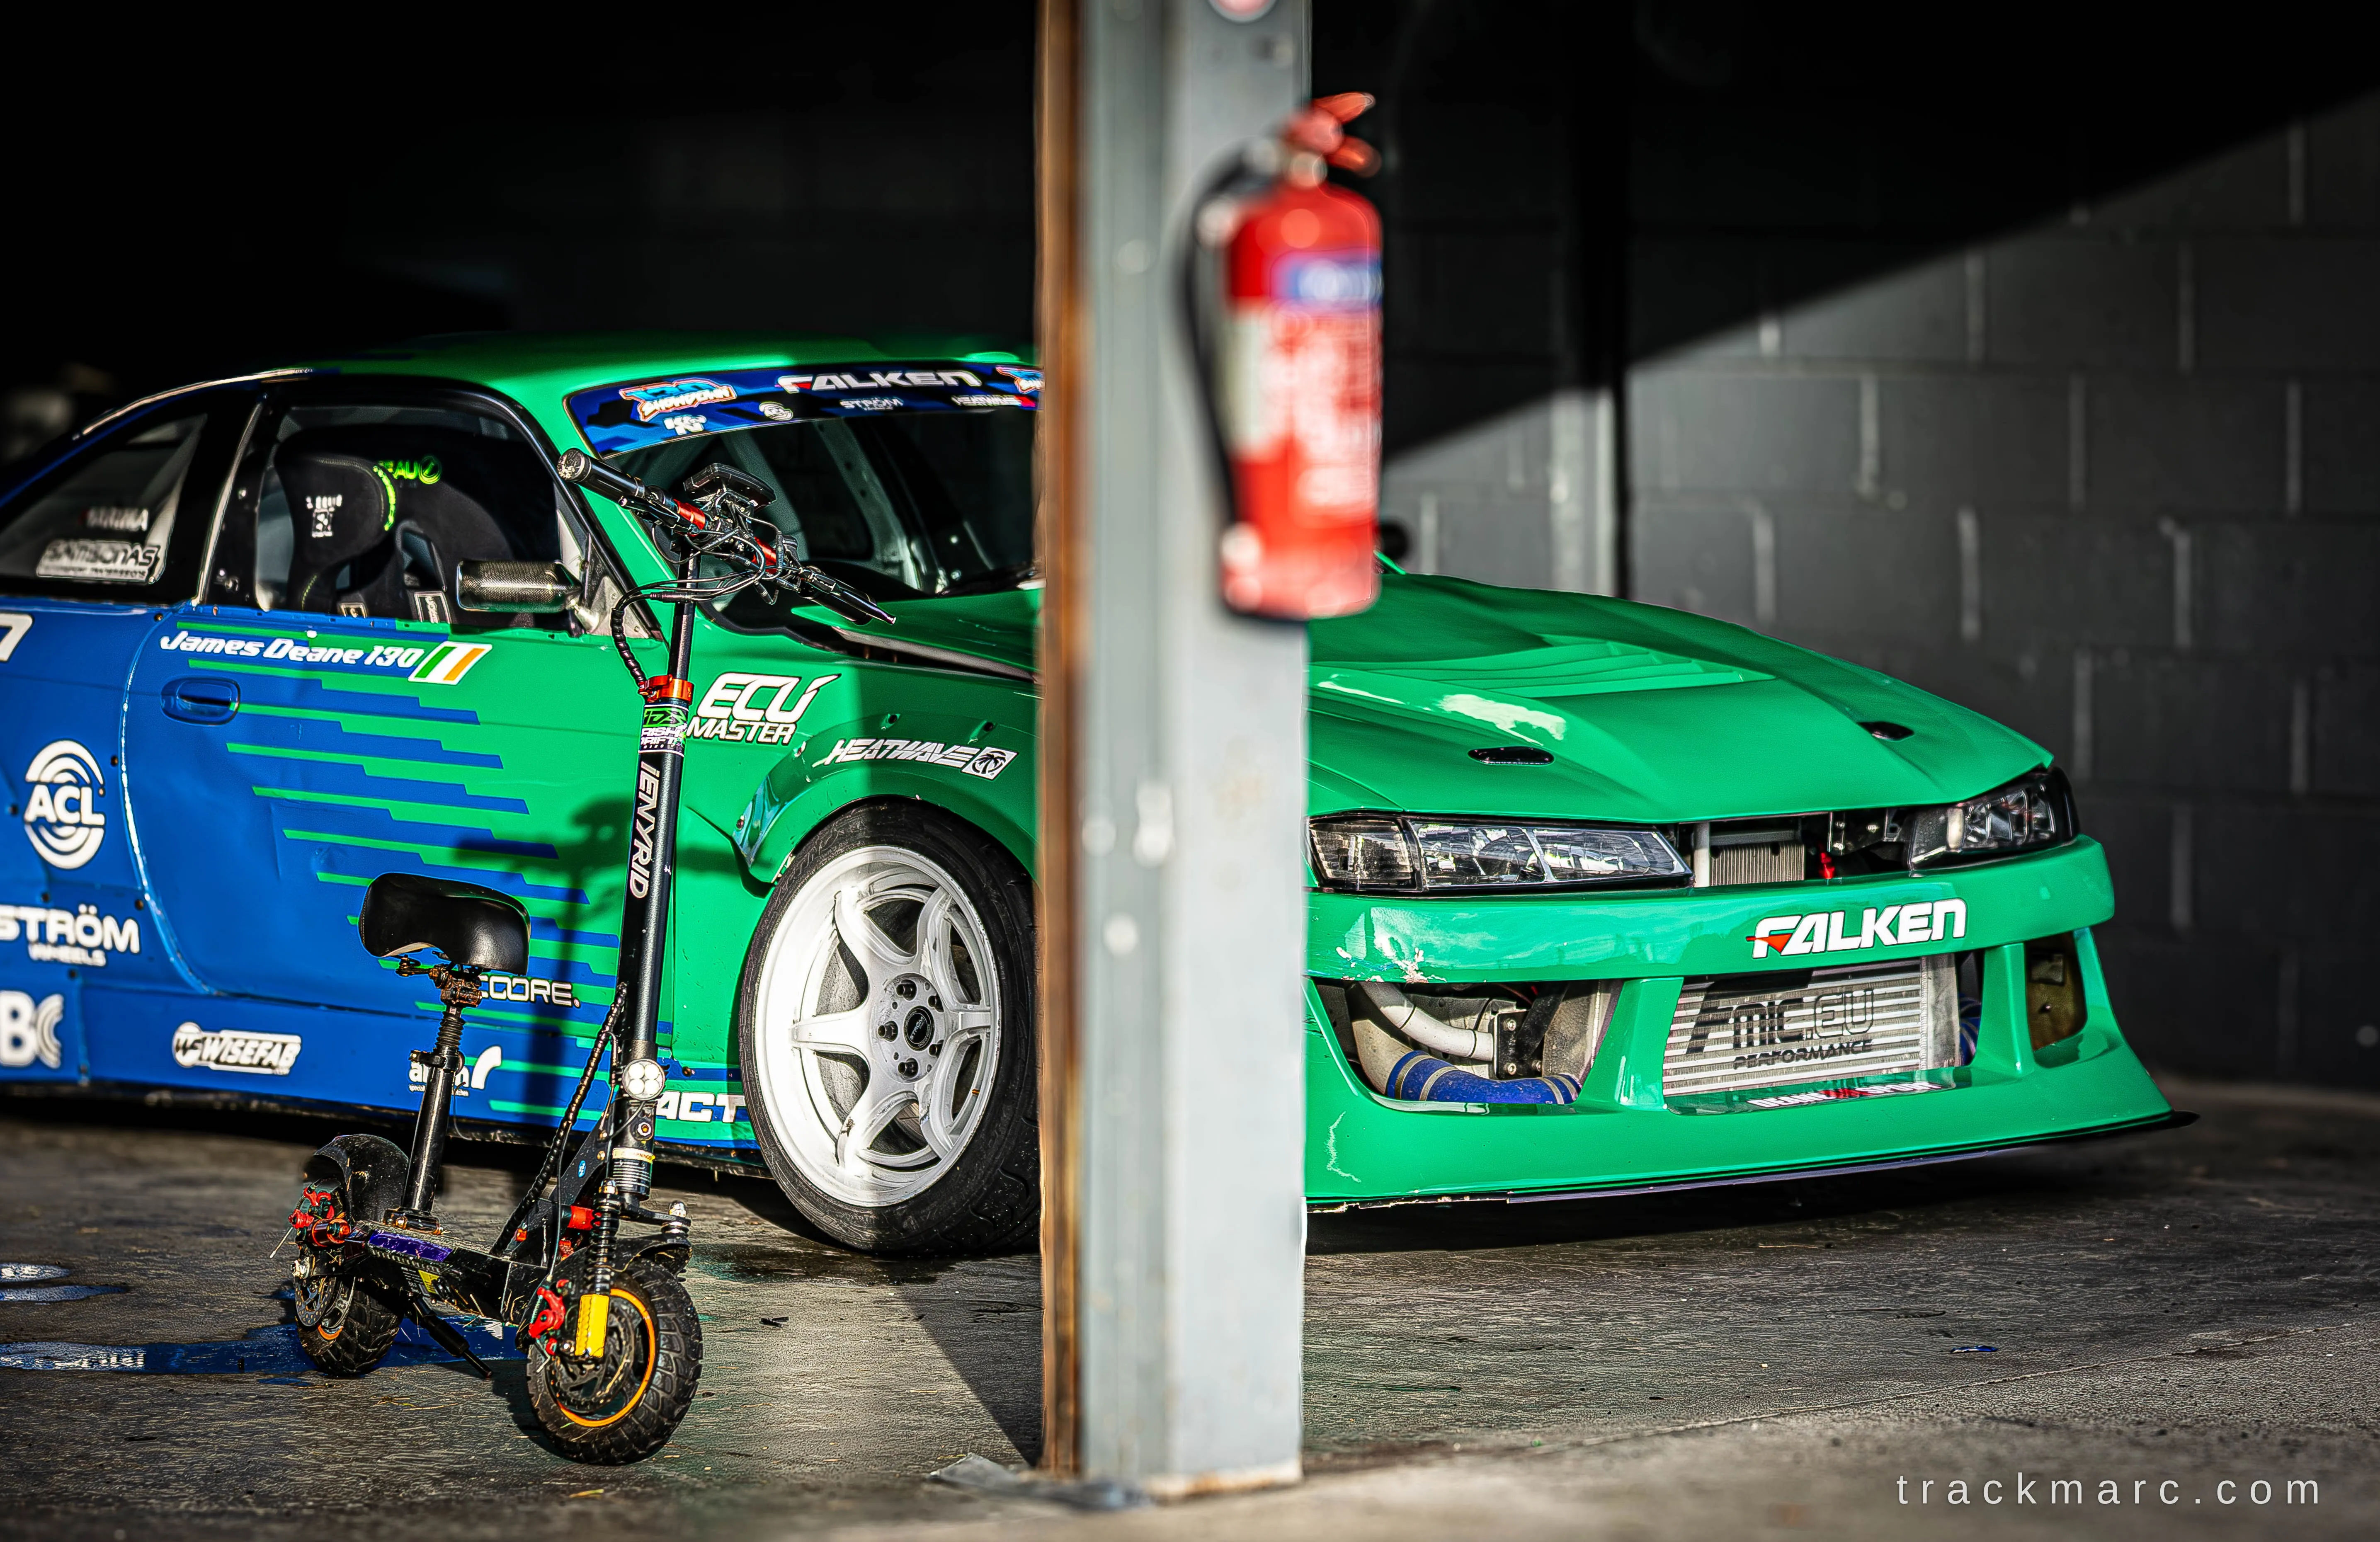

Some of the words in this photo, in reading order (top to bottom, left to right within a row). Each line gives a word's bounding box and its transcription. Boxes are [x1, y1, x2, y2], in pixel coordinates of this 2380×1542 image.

[776, 371, 982, 393] FALKEN
[642, 387, 730, 416] SHOWDOWN
[159, 630, 265, 657] James
[263, 638, 364, 665] Deane
[364, 645, 425, 668] 130
[697, 672, 842, 723] ECU
[686, 717, 797, 744] MASTER
[824, 739, 980, 768] HEATWAVE
[24, 785, 105, 825] ACL
[0, 903, 140, 954] STRÖM
[1747, 898, 1966, 958] FALKEN
[201, 1035, 301, 1068] WISEFAB
[1733, 1038, 1873, 1070] PERFORMANCE
[1747, 1093, 1837, 1108] DEANE
[1855, 1081, 1942, 1095] SPORT
